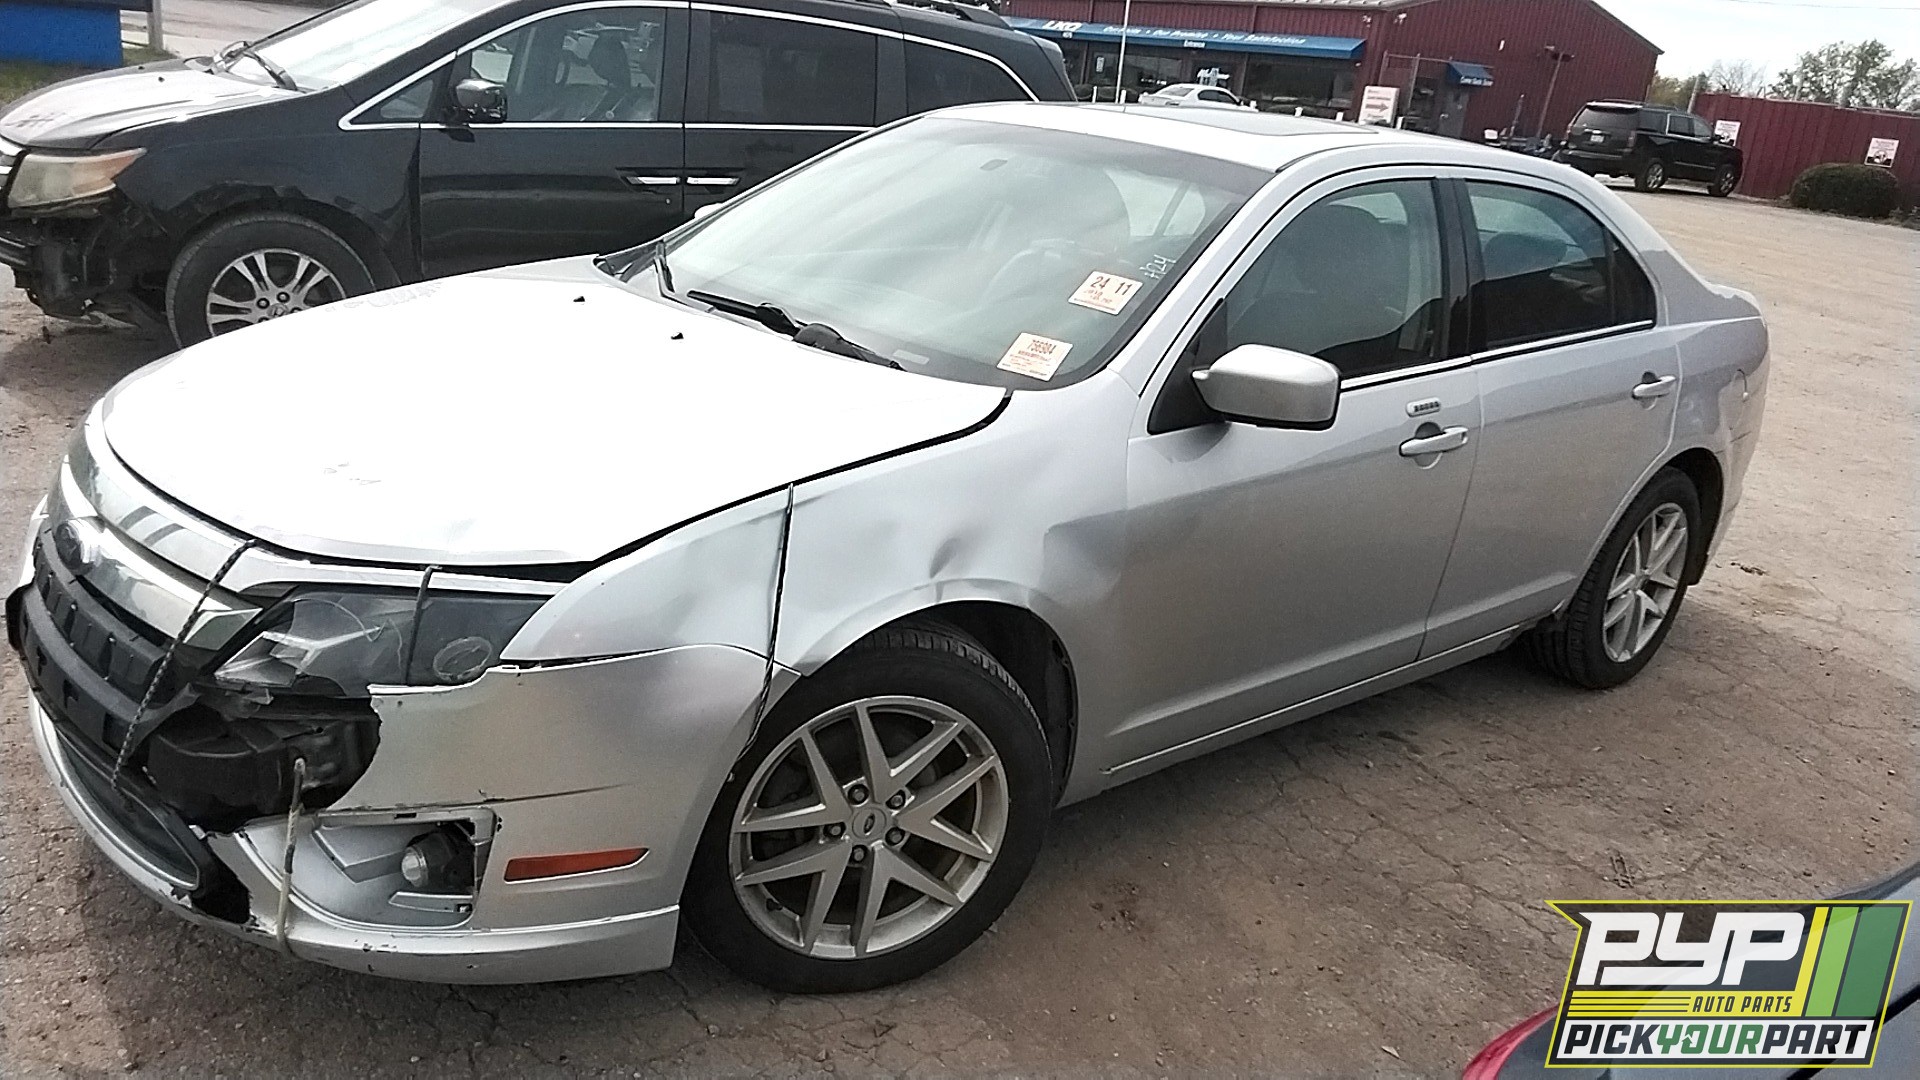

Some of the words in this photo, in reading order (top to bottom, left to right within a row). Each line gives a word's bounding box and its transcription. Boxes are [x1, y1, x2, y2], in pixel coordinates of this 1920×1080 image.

[1042, 20, 1083, 32] LKQ
[1090, 276, 1111, 289] 24
[1115, 282, 1132, 296] 11
